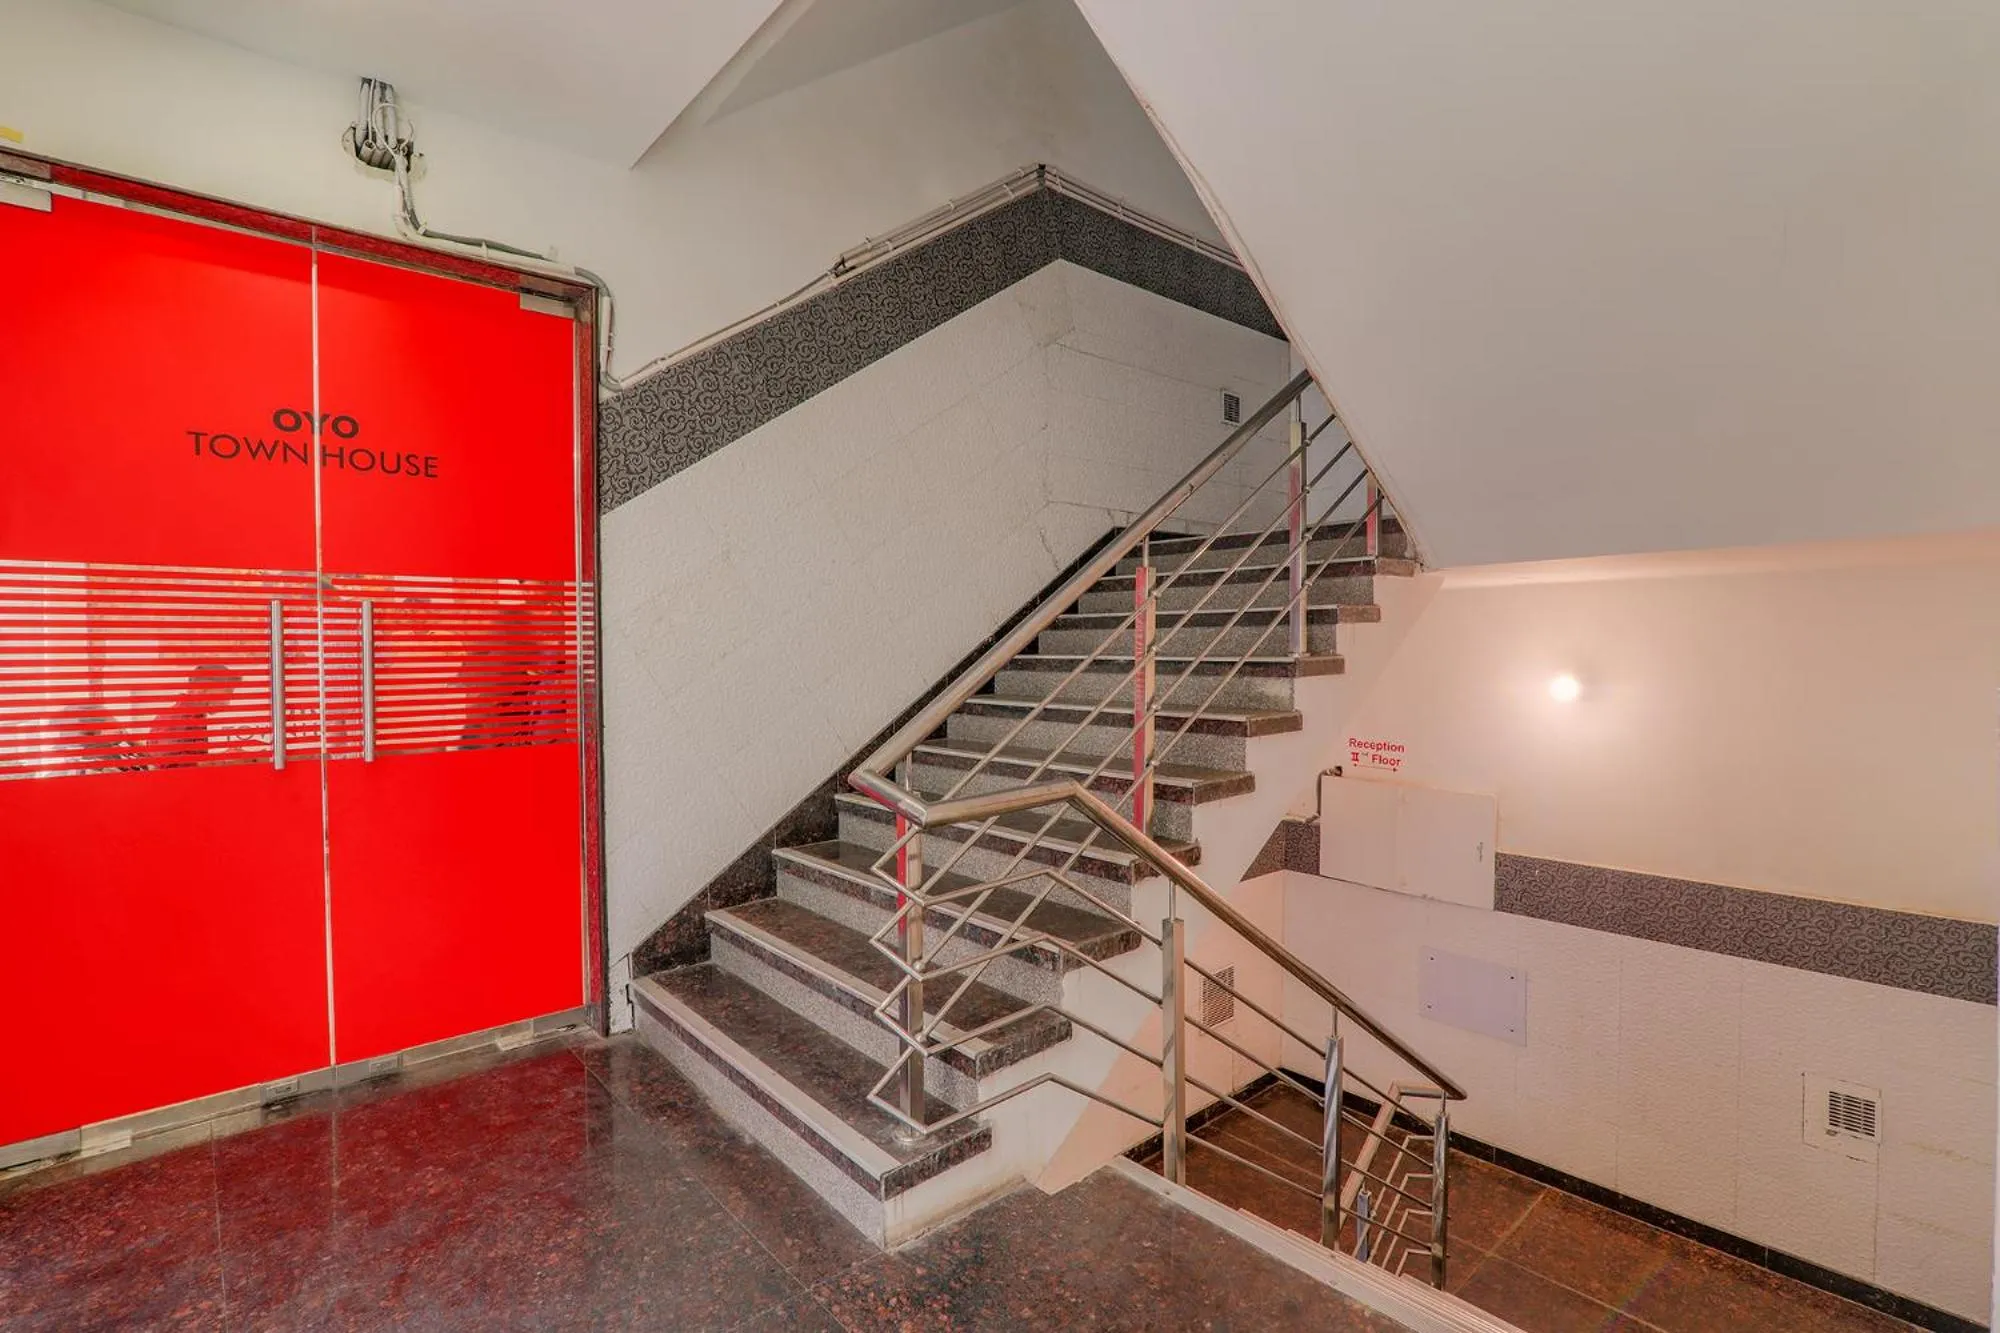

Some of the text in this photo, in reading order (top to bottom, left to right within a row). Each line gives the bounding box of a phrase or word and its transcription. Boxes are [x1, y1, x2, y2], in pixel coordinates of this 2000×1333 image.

[272, 408, 360, 439] OYO
[1349, 738, 1405, 753] Reception
[1371, 753, 1401, 767] Floor
